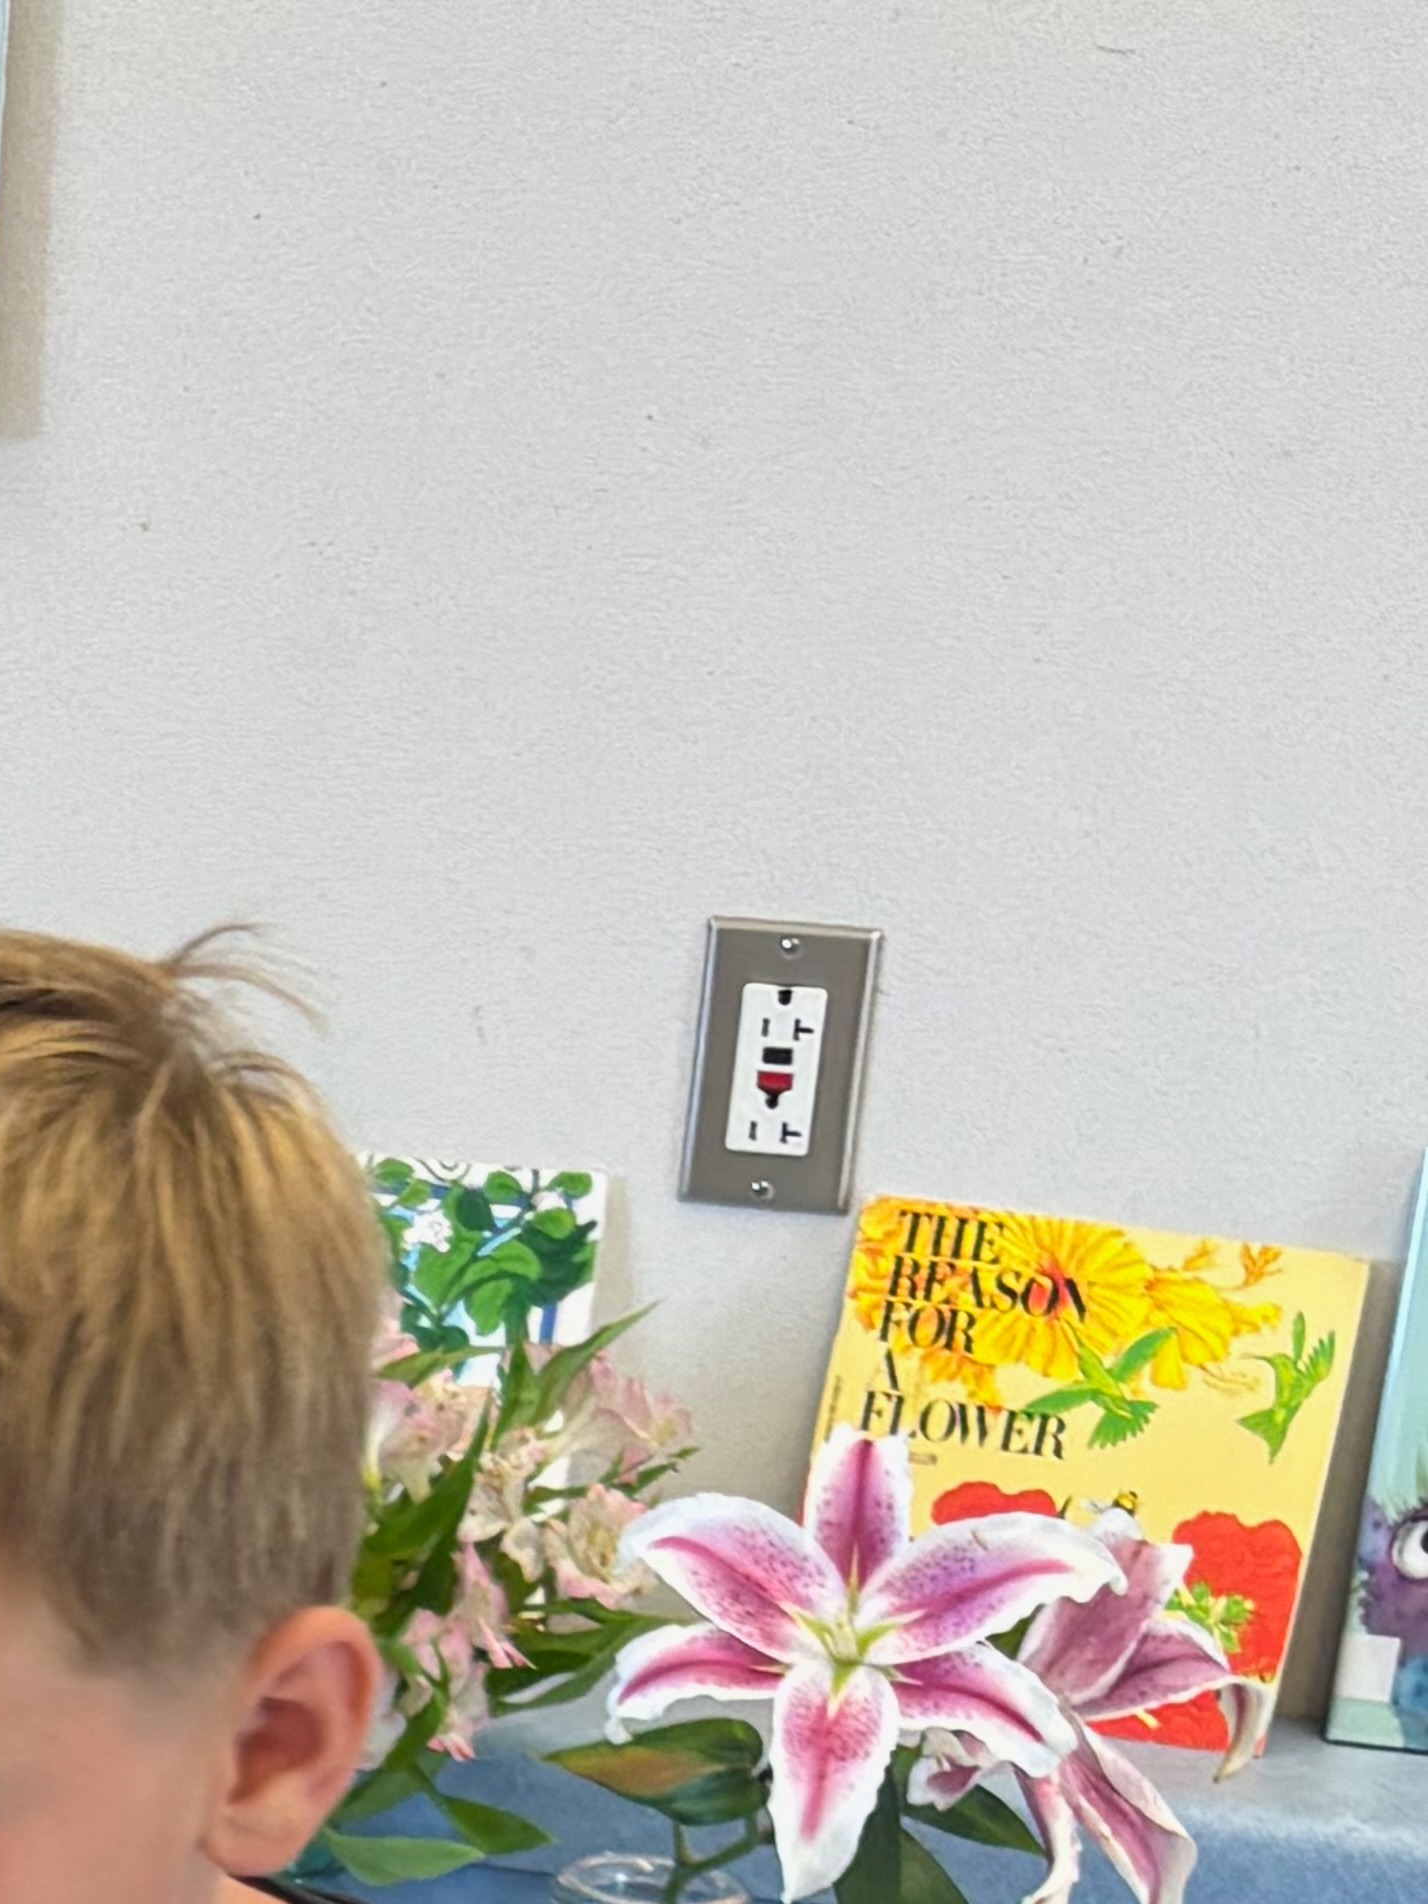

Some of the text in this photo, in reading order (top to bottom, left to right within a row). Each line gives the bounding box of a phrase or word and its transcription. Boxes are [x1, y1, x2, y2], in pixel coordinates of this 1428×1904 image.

[899, 1208, 1006, 1266] THE
[887, 1254, 1087, 1325] REASON
[879, 1299, 976, 1356] FOR
[866, 1347, 901, 1392] A
[860, 1389, 1067, 1461] FLOWER
